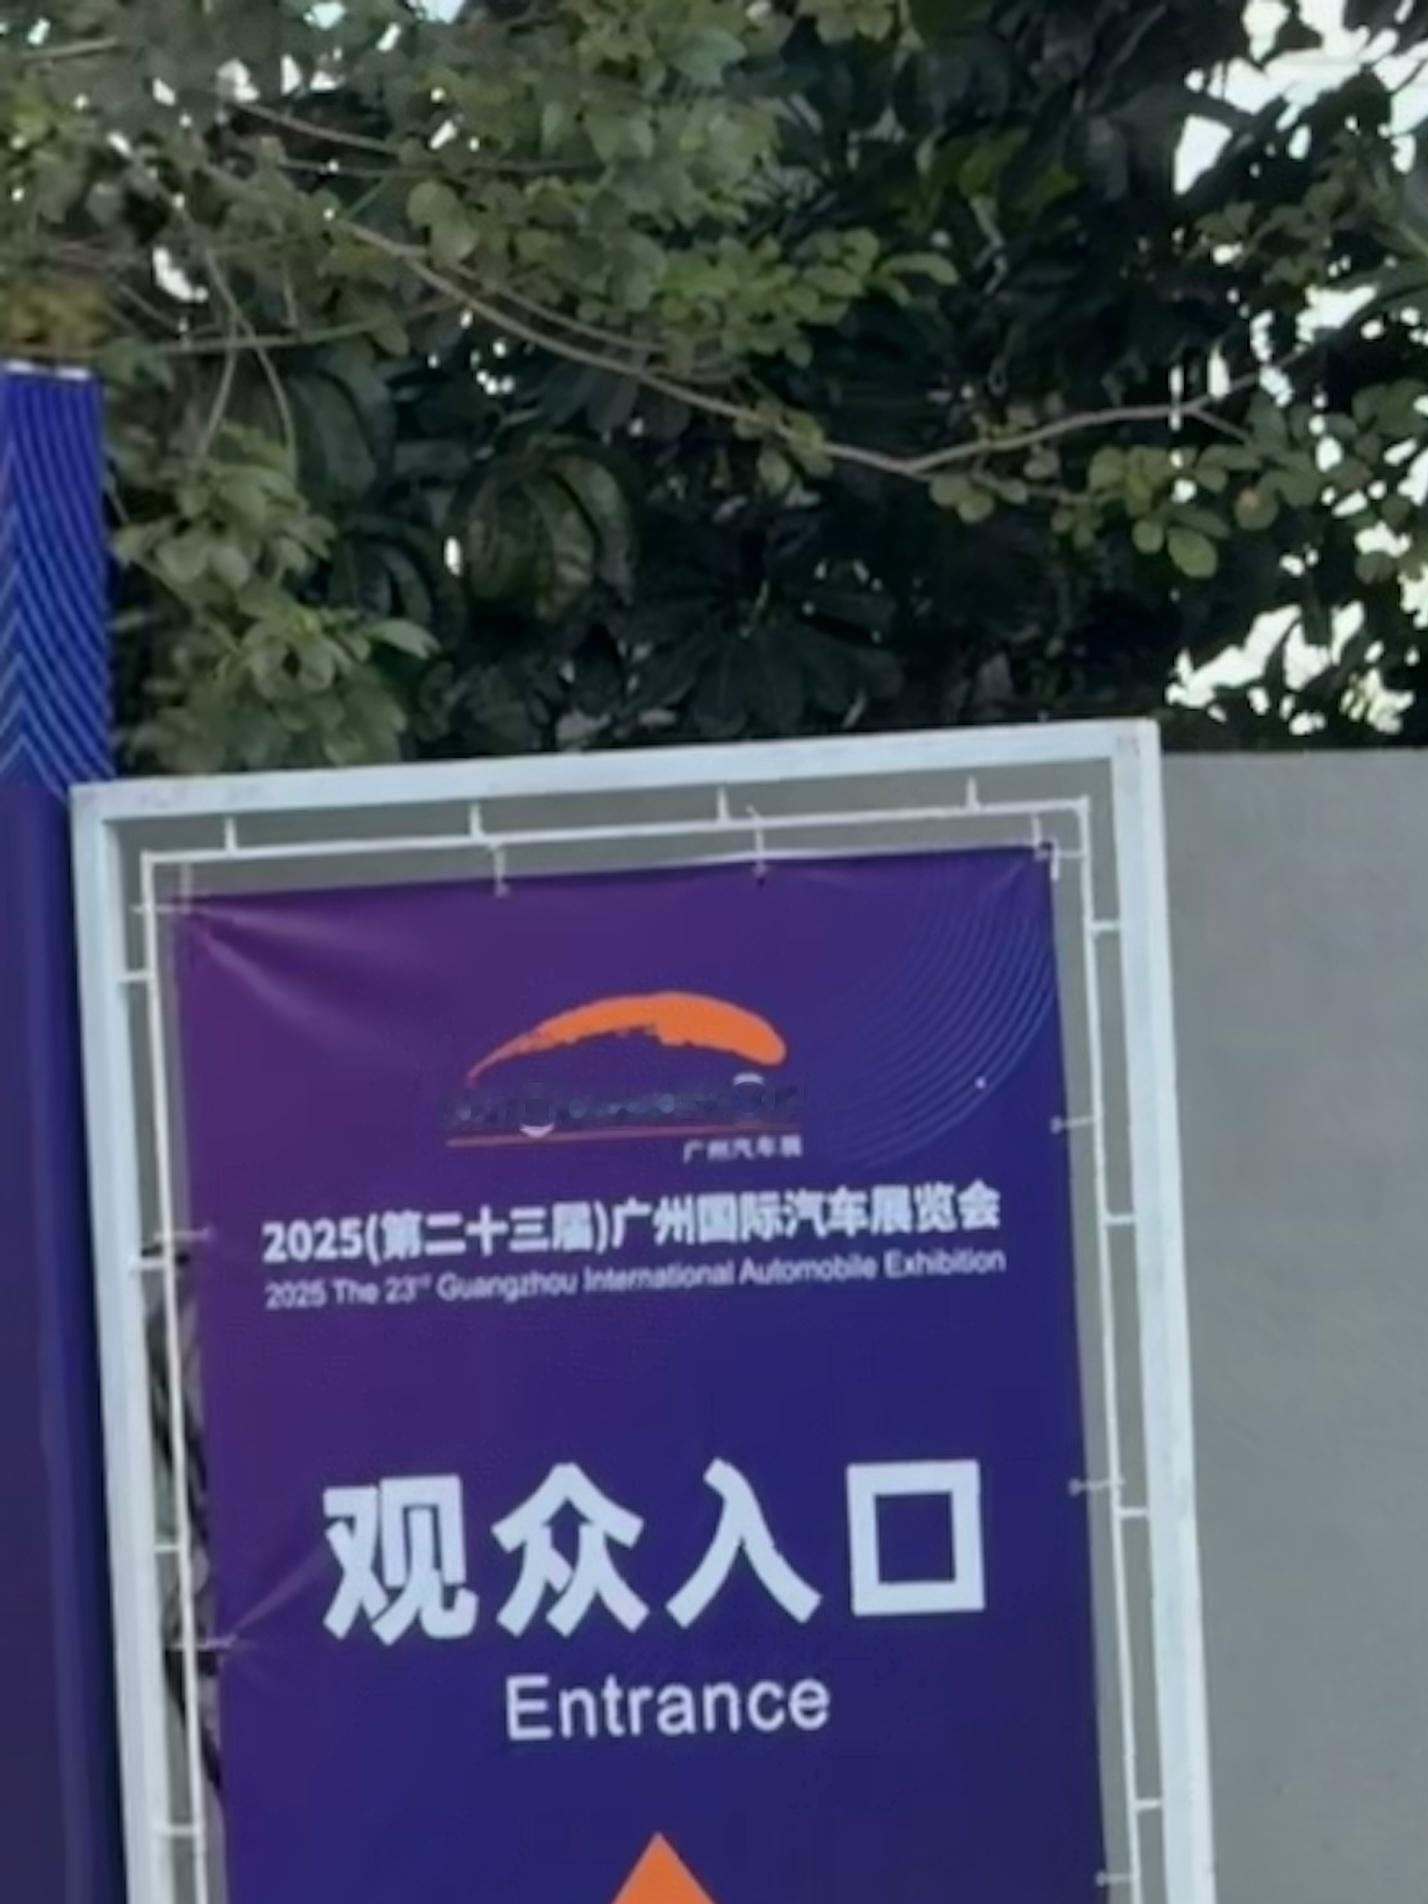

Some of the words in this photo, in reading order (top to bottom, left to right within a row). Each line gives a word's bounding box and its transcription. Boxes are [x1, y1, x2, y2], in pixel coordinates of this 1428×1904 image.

[264, 1279, 327, 1309] 2025
[333, 1277, 379, 1304] The
[436, 1265, 579, 1304] Guangzhou
[584, 1259, 735, 1293] International
[740, 1253, 878, 1286] Automobile
[883, 1246, 1007, 1280] Exhibition
[323, 1458, 987, 1647] 观众入口
[507, 1675, 831, 1741] Entrance
